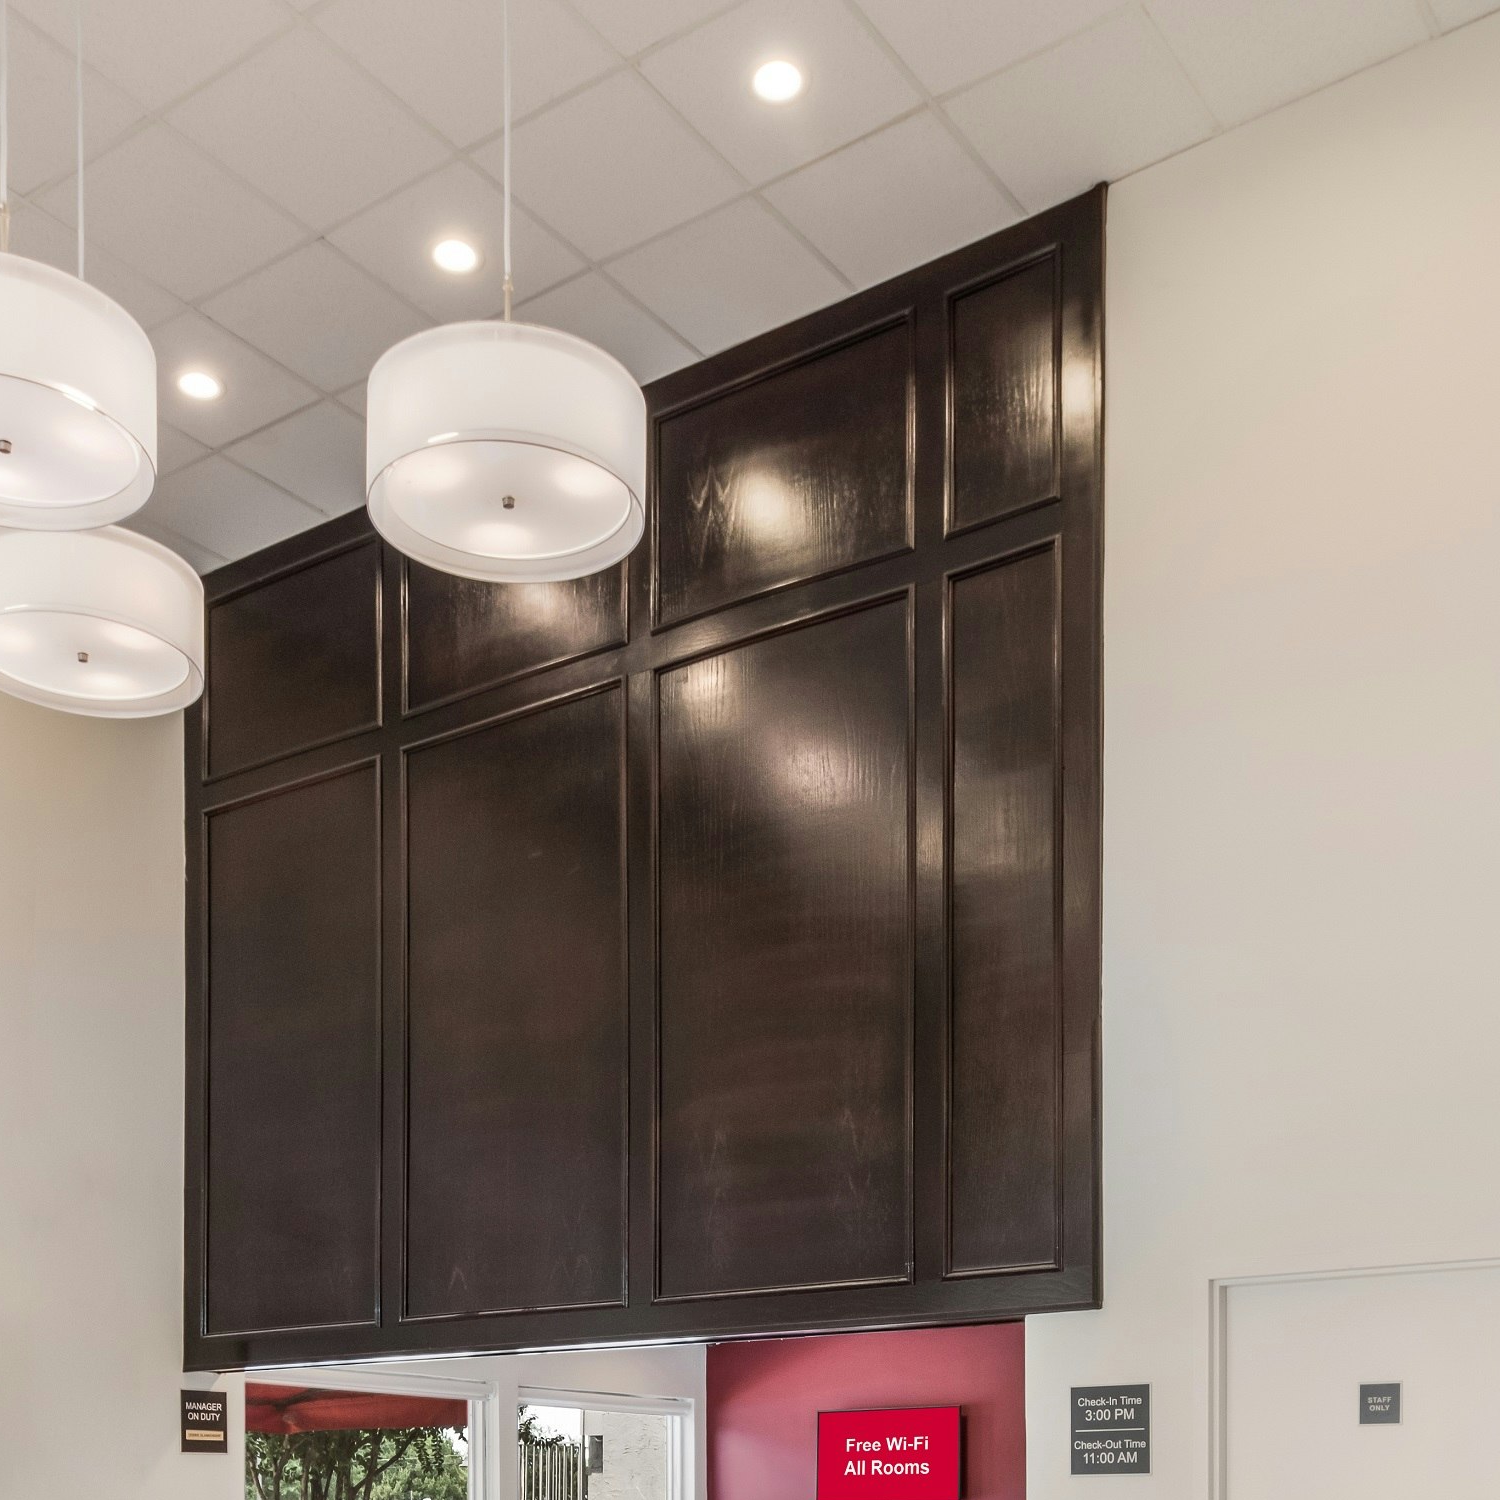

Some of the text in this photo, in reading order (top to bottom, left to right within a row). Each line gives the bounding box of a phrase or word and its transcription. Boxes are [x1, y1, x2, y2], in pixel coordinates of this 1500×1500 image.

[1077, 1395, 1142, 1407] Check-In Time
[1367, 1396, 1392, 1404] STAFF
[185, 1401, 222, 1411] MANAGER
[1369, 1404, 1390, 1412] ONLY
[187, 1412, 220, 1421] ON DUTY
[1085, 1408, 1134, 1421] 3:00 PM
[846, 1436, 929, 1452] Free Wi-Fi
[1074, 1439, 1146, 1450] Check-Out Time
[1083, 1451, 1137, 1464] 11:00 AM
[844, 1460, 930, 1475] All Rooms
